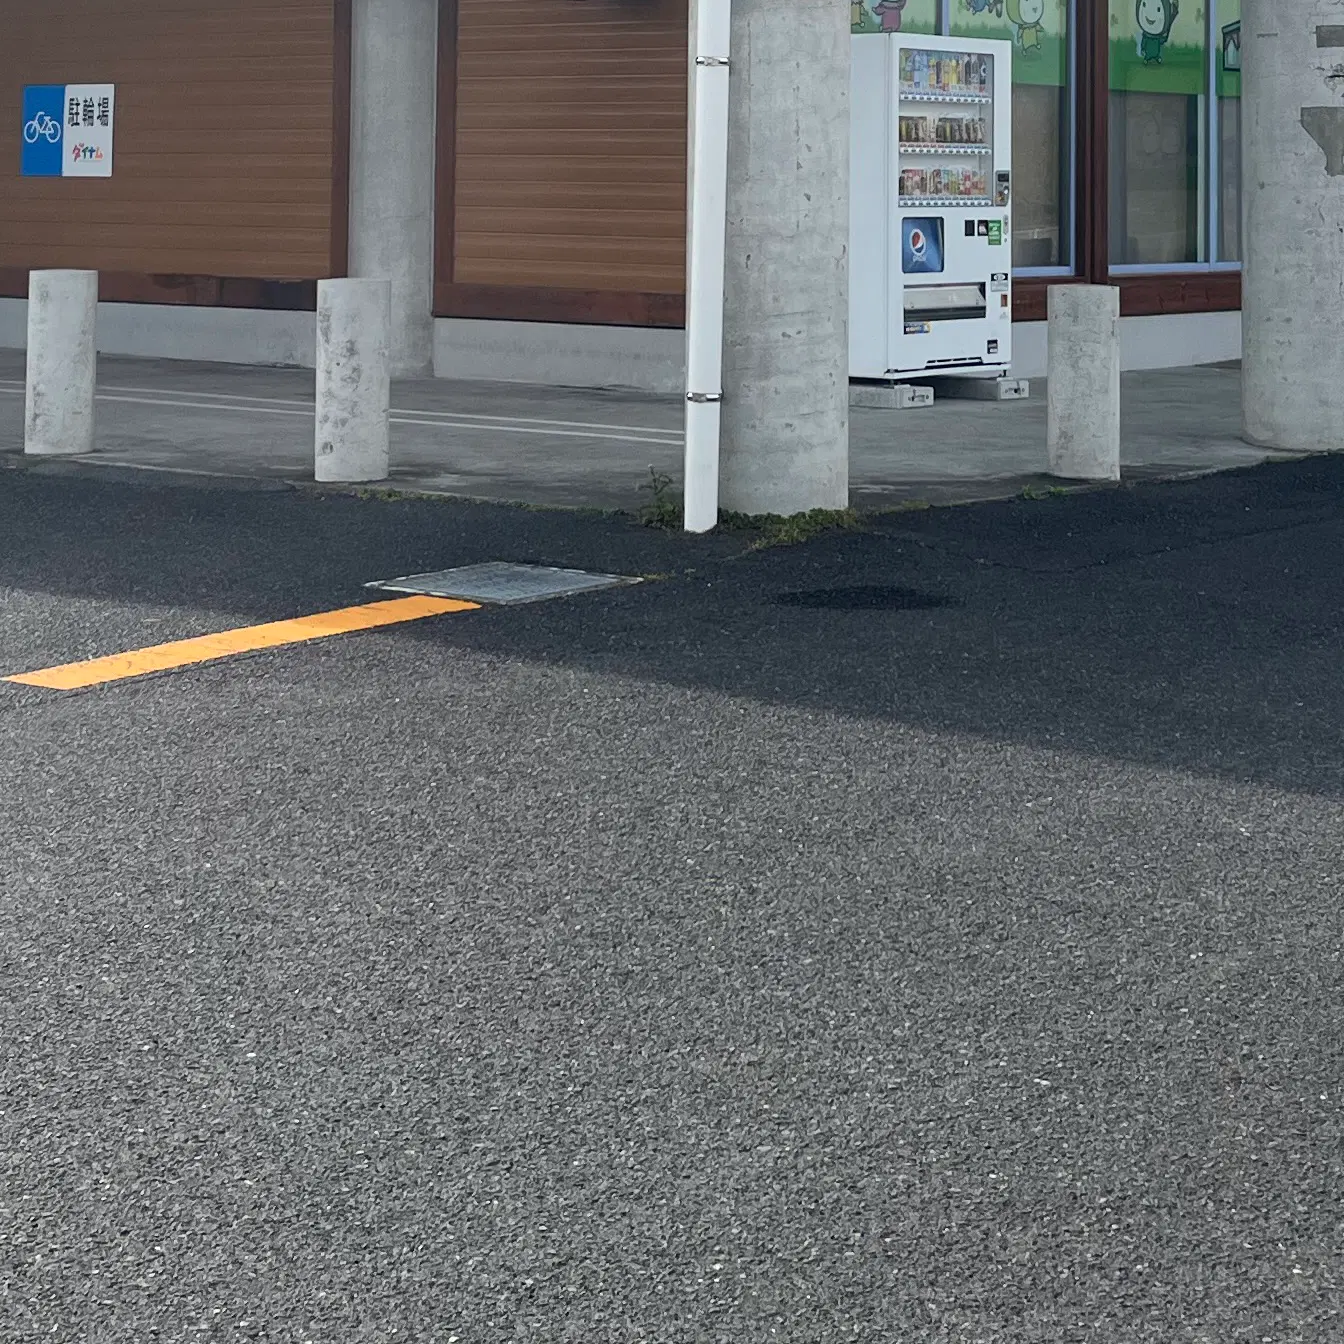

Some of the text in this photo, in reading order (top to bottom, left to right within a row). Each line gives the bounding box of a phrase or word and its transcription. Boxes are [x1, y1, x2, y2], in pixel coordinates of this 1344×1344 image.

[68, 97, 109, 127] 駐輪場
[72, 142, 104, 162] ダイナム
